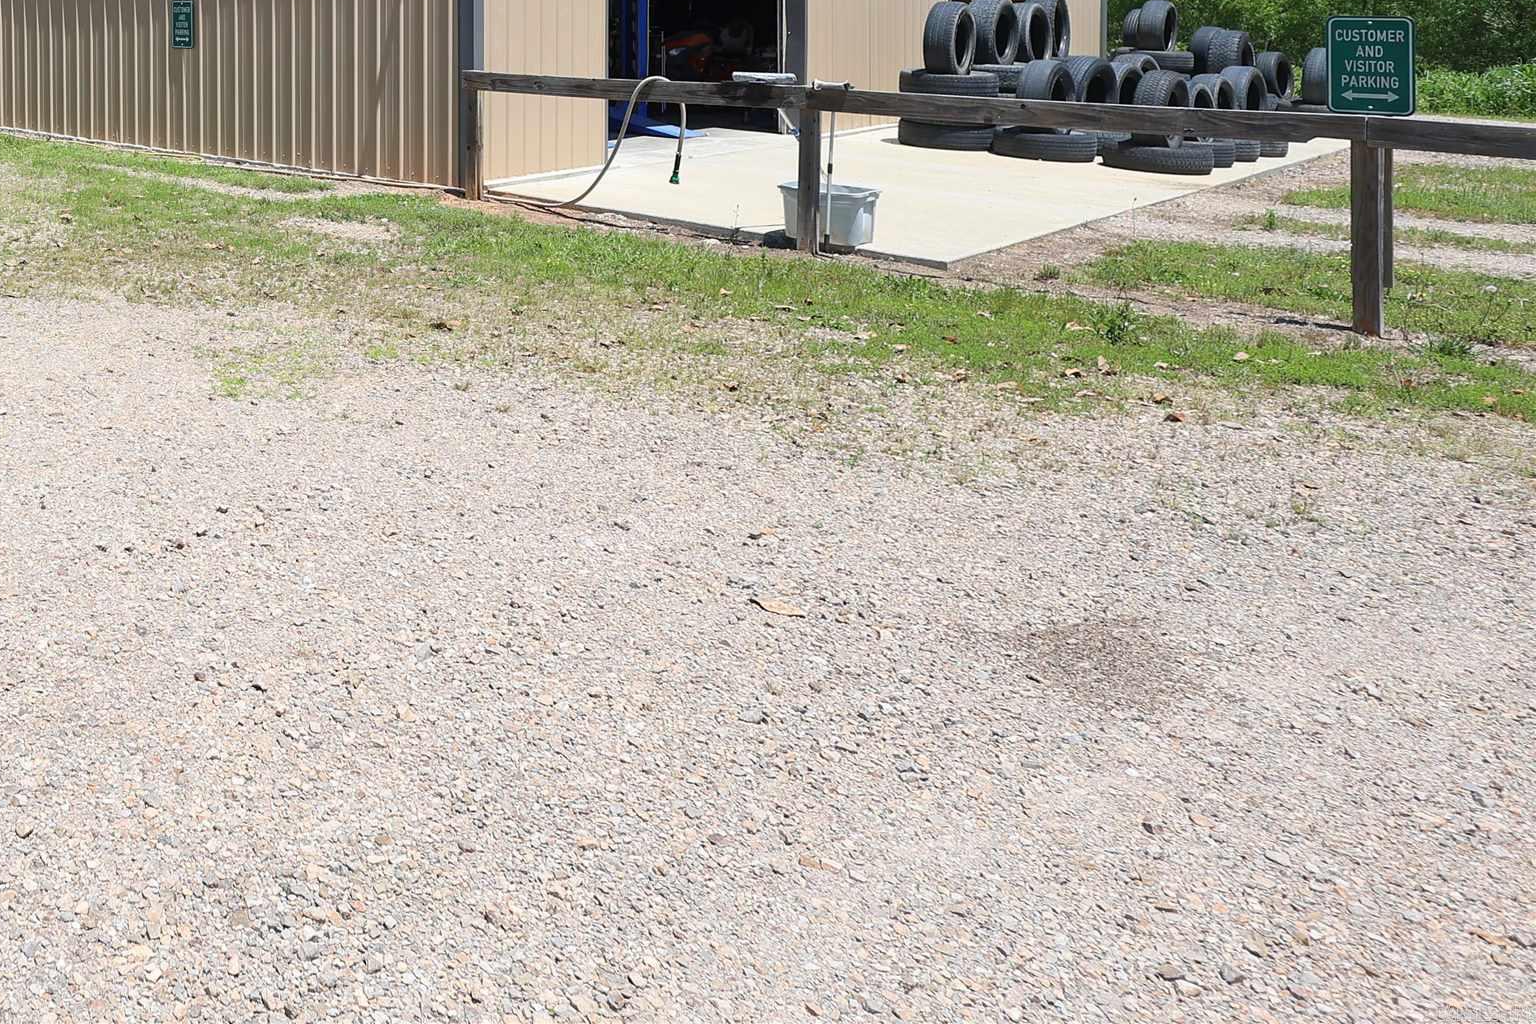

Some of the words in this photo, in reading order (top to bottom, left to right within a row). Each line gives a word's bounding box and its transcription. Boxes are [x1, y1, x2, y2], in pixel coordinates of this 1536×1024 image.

[1335, 29, 1405, 43] CUSTOMER
[1355, 45, 1384, 58] AND
[1344, 59, 1395, 73] VISITOR
[1341, 74, 1400, 89] PARKING
